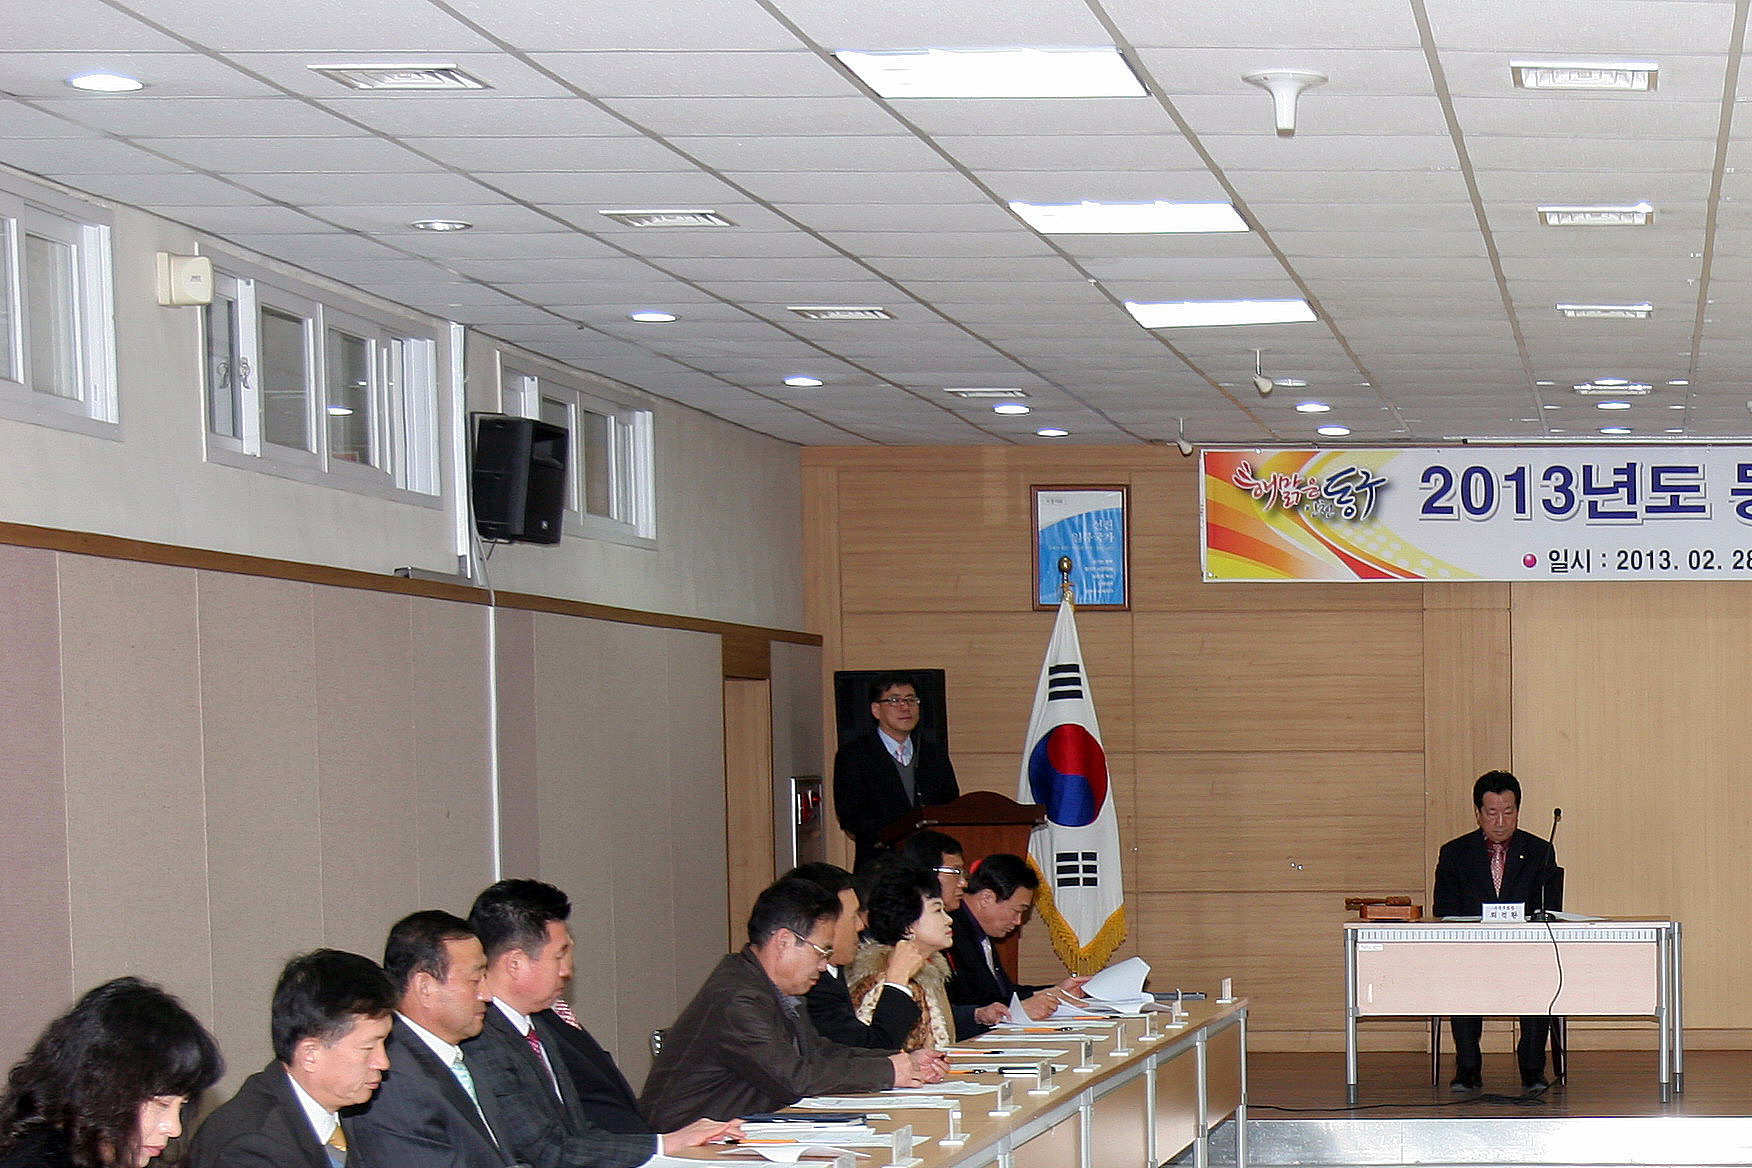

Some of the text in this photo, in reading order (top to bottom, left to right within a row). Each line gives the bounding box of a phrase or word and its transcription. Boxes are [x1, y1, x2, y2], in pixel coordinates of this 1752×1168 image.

[1322, 466, 1388, 521] 동구
[1420, 461, 1709, 522] 2013년도
[1548, 550, 1594, 574] 일시
[1616, 550, 1678, 572] 2013.
[1688, 550, 1722, 572] 02.
